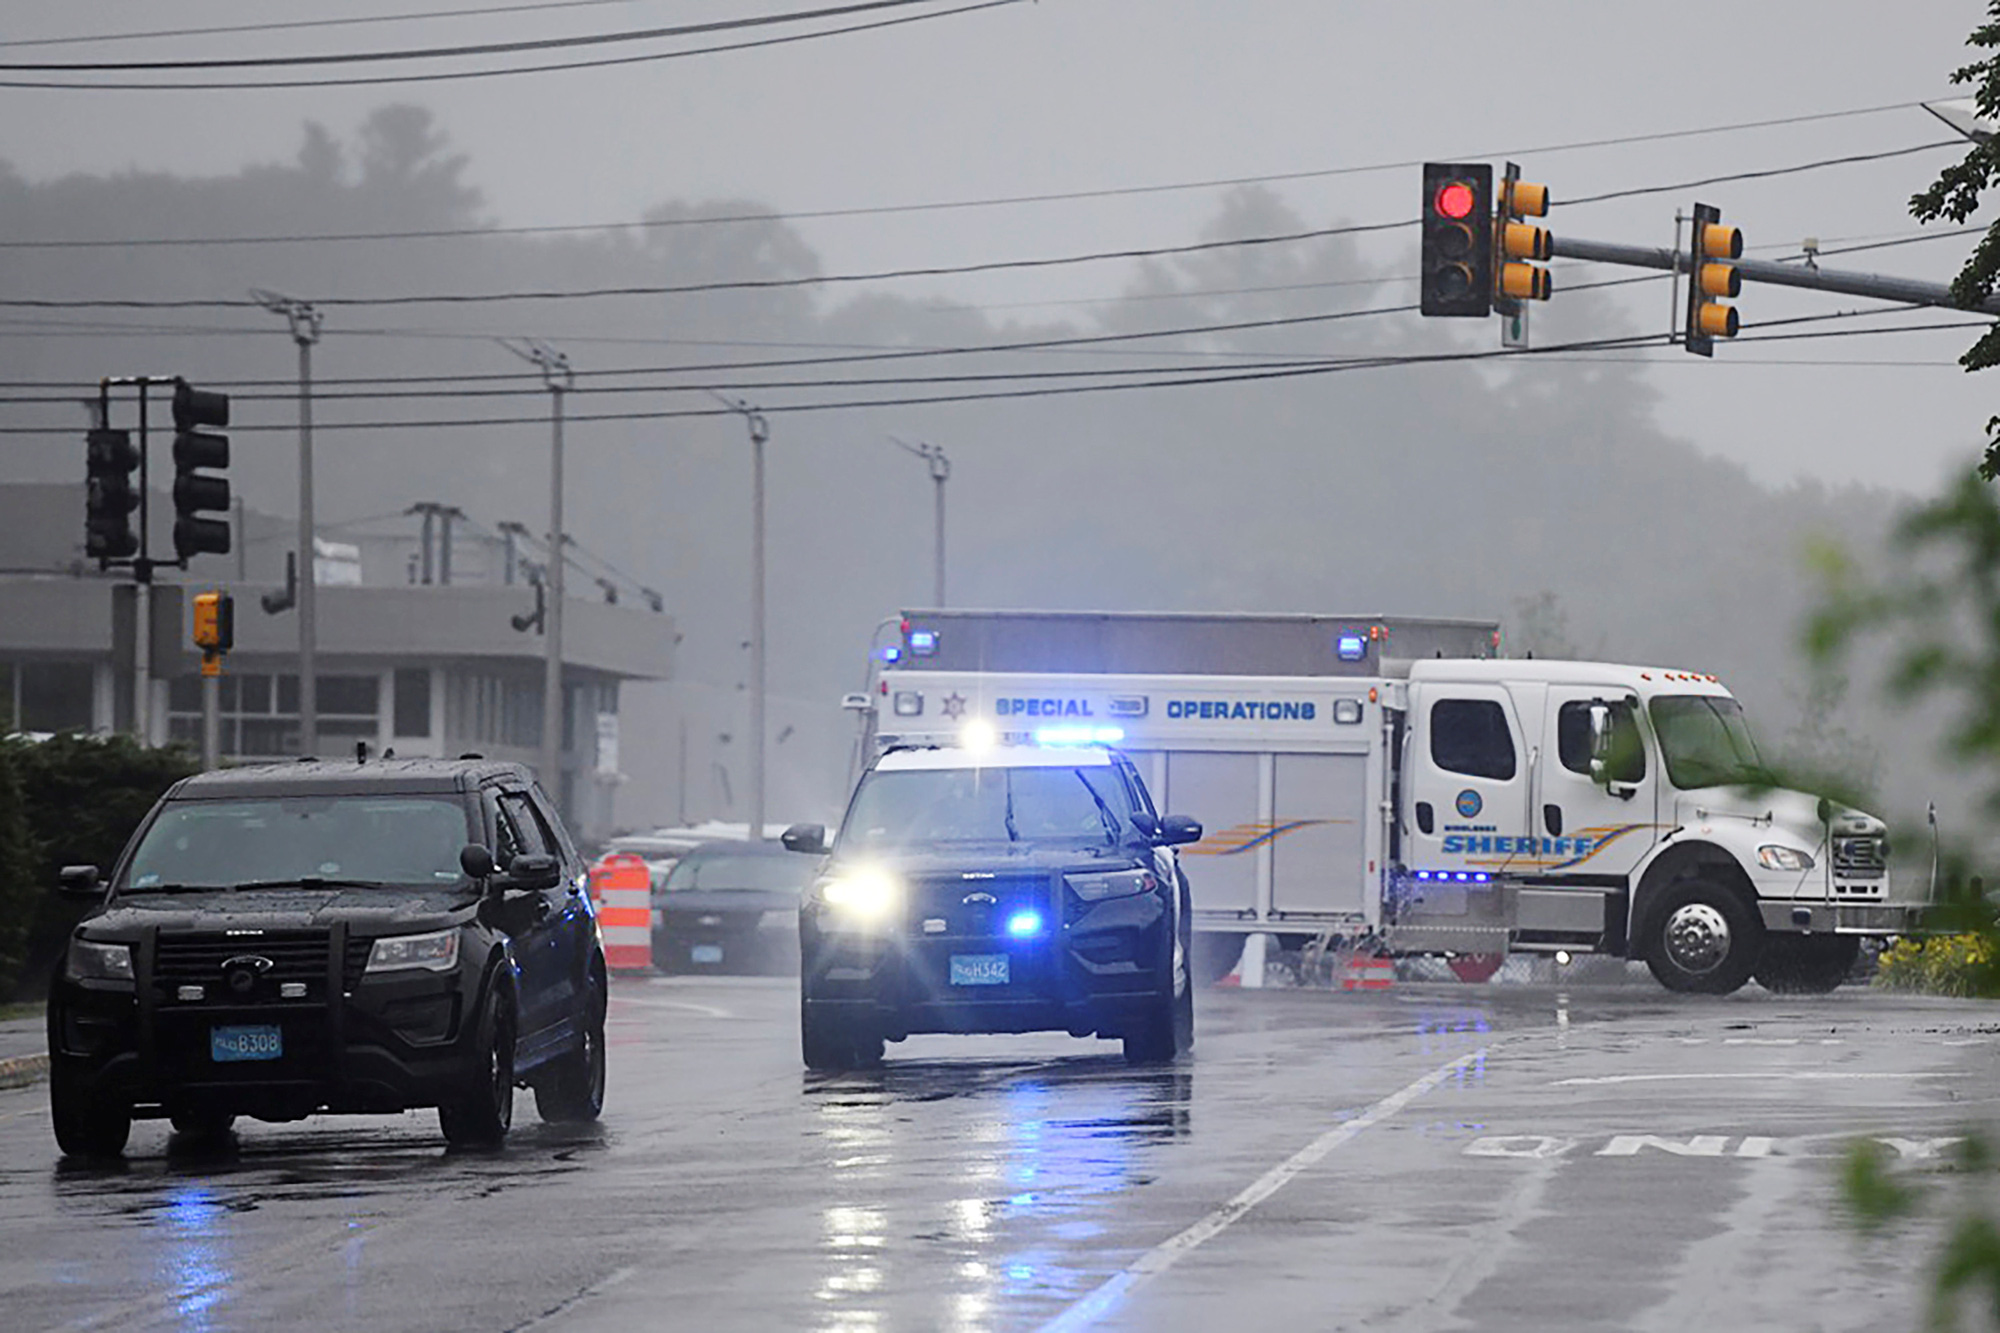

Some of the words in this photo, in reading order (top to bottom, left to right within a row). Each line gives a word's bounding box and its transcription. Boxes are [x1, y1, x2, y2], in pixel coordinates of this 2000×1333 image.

[995, 698, 1094, 717] SPECIAL
[1166, 700, 1316, 720] OPERATIONS
[1442, 835, 1593, 855] SHERIFF
